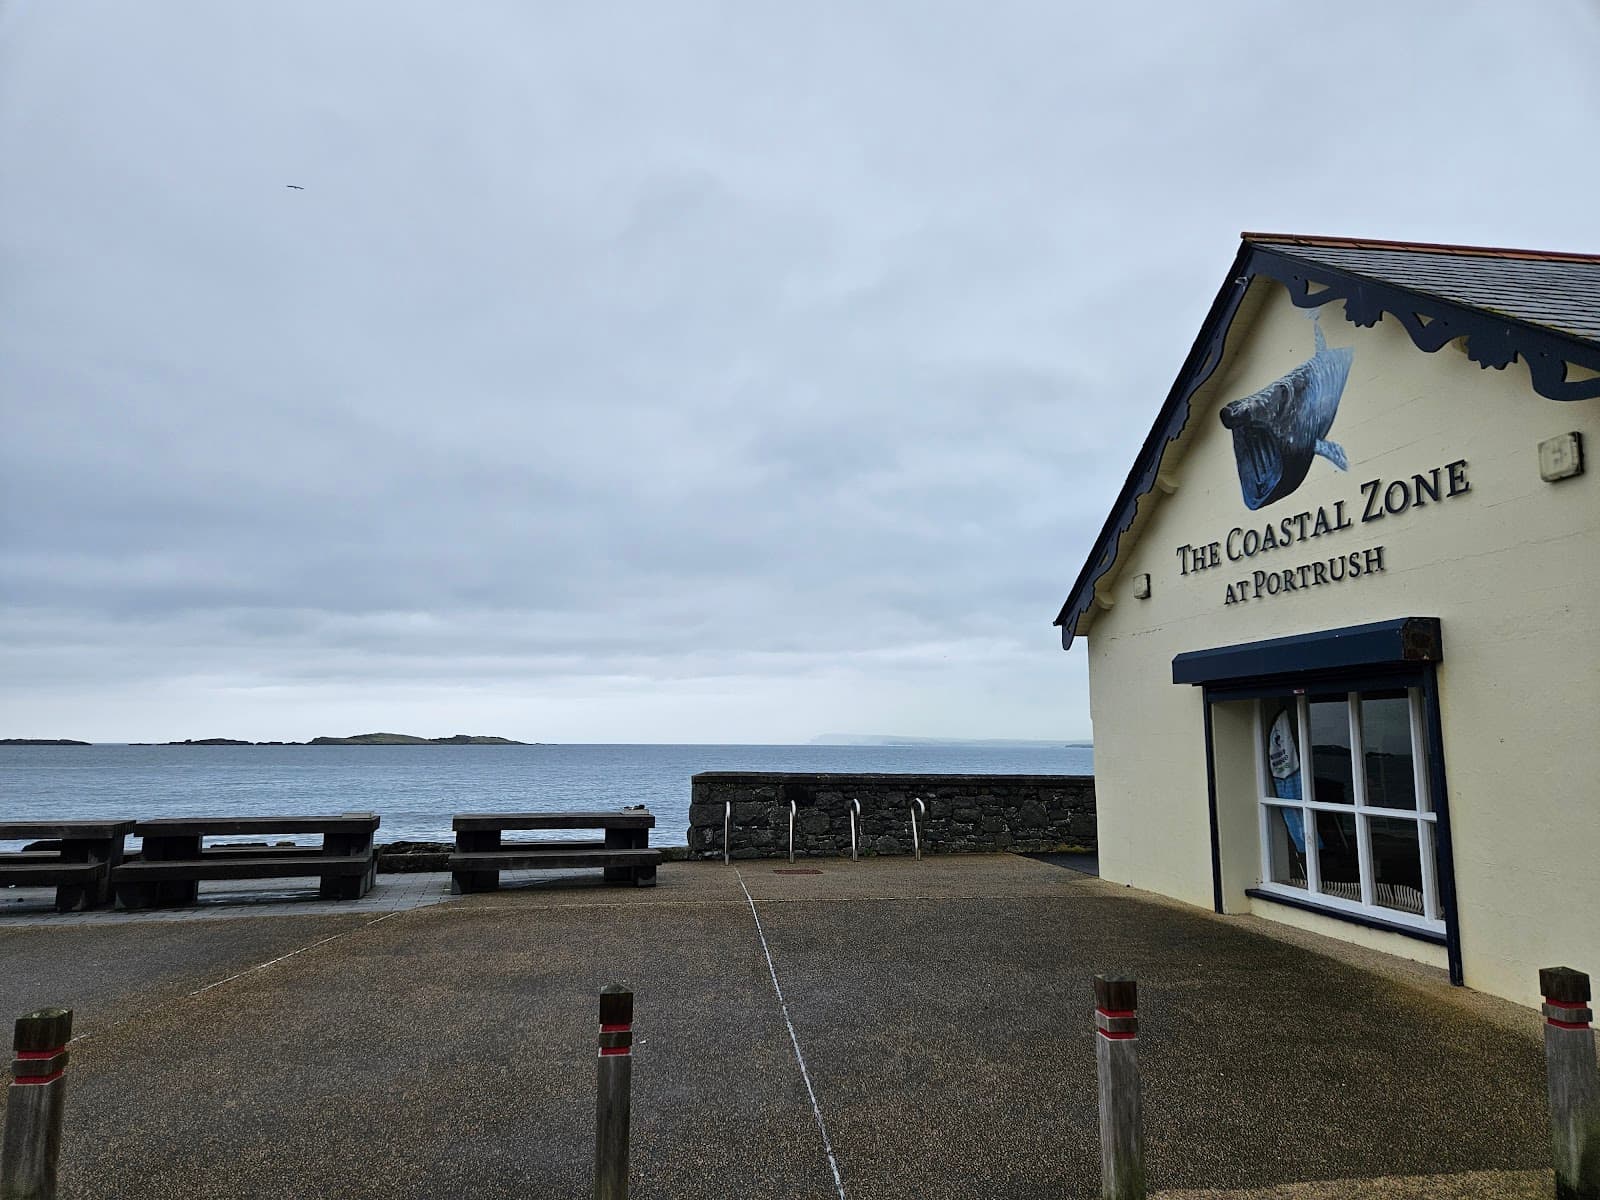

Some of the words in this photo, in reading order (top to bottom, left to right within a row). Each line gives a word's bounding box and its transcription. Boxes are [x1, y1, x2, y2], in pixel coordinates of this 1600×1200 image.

[1176, 543, 1221, 576] THE
[1226, 500, 1352, 562] COASTAL
[1360, 459, 1471, 523] ZONE
[1224, 580, 1249, 605] AT
[1252, 546, 1386, 599] PORTRUSH
